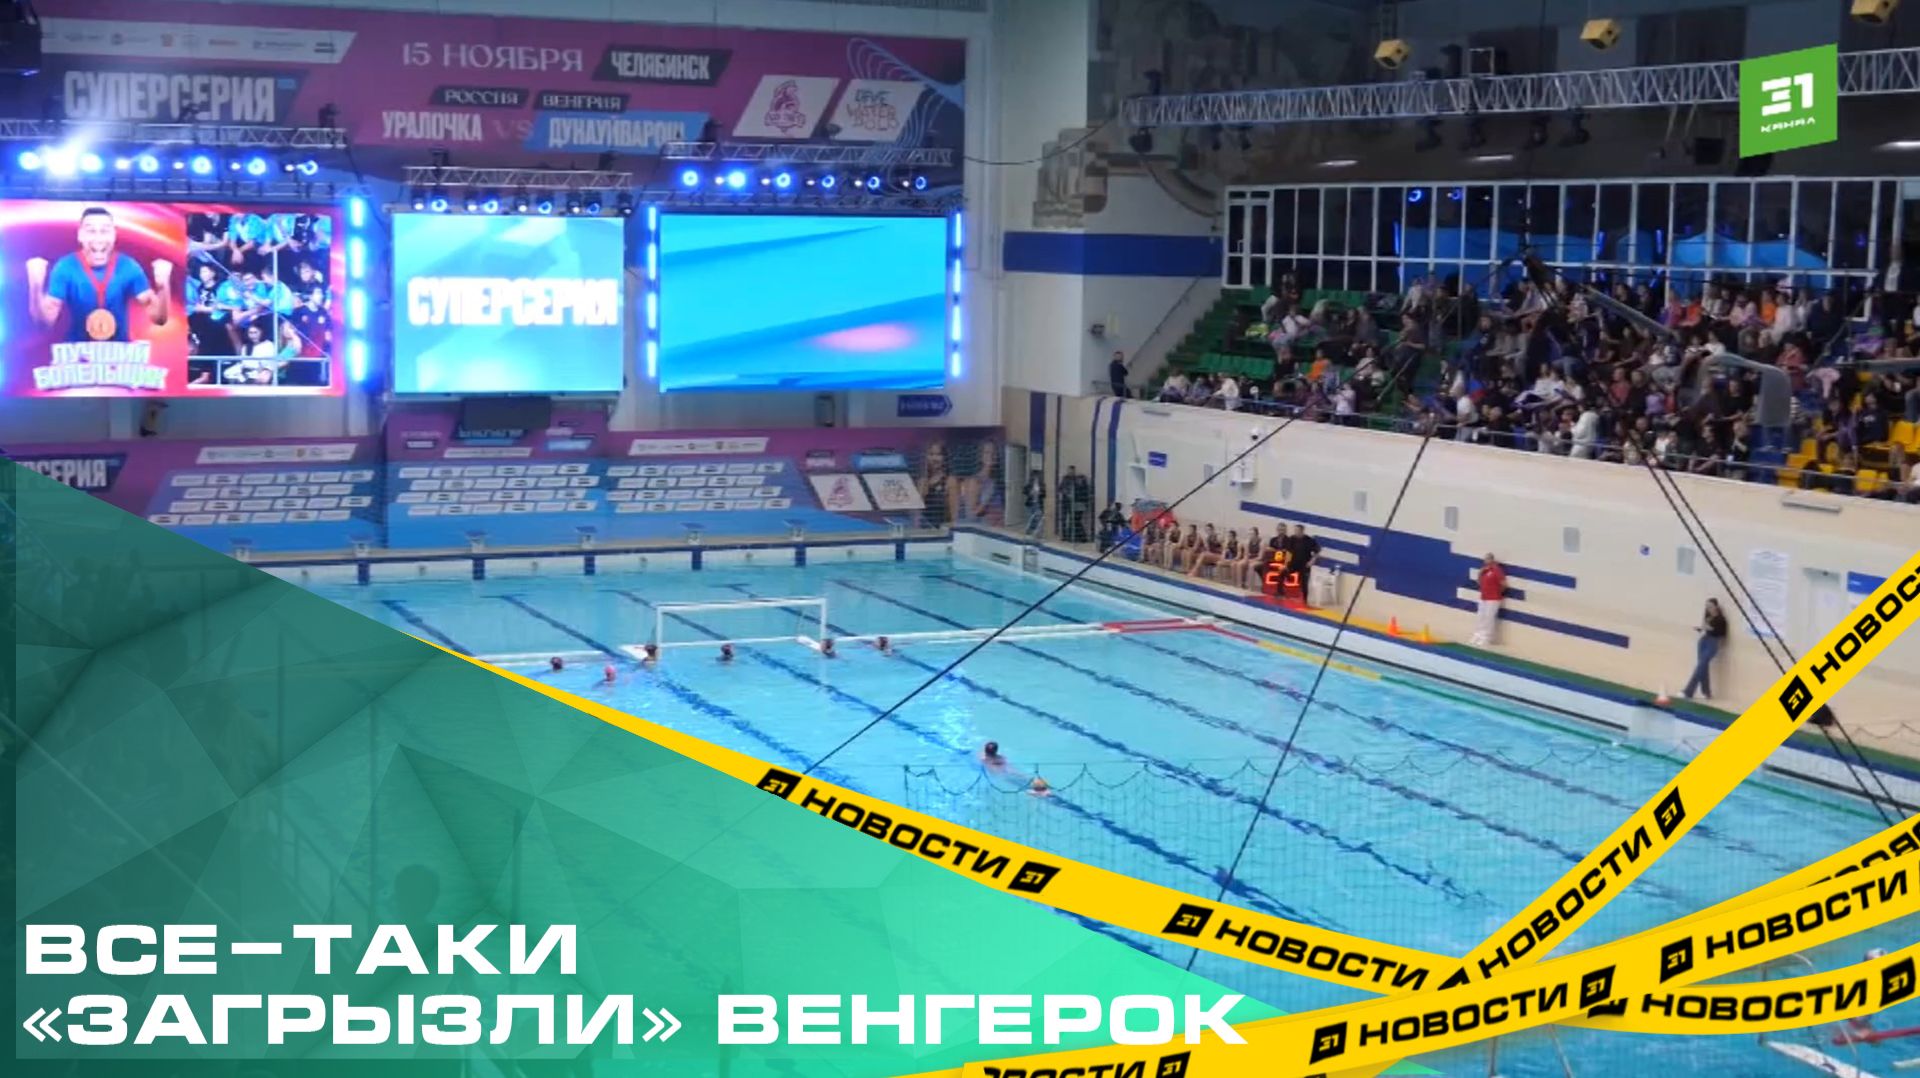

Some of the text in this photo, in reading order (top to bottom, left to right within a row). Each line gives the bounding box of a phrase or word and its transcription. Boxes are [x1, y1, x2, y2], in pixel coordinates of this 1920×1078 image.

[403, 42, 583, 72] 15 НОЯБРЯ
[611, 50, 710, 80] ЧЕЛЯБИНСК
[64, 70, 275, 122] СУПЕРСЕРИЯ
[445, 89, 518, 105] РОССИЯ
[543, 95, 621, 110] ВЕНГРИЯ
[382, 111, 482, 142] УРАЛОЧКА
[407, 277, 618, 327] СУПЕРСЕРИЯ
[51, 341, 151, 365] ЛУЧШИЙ
